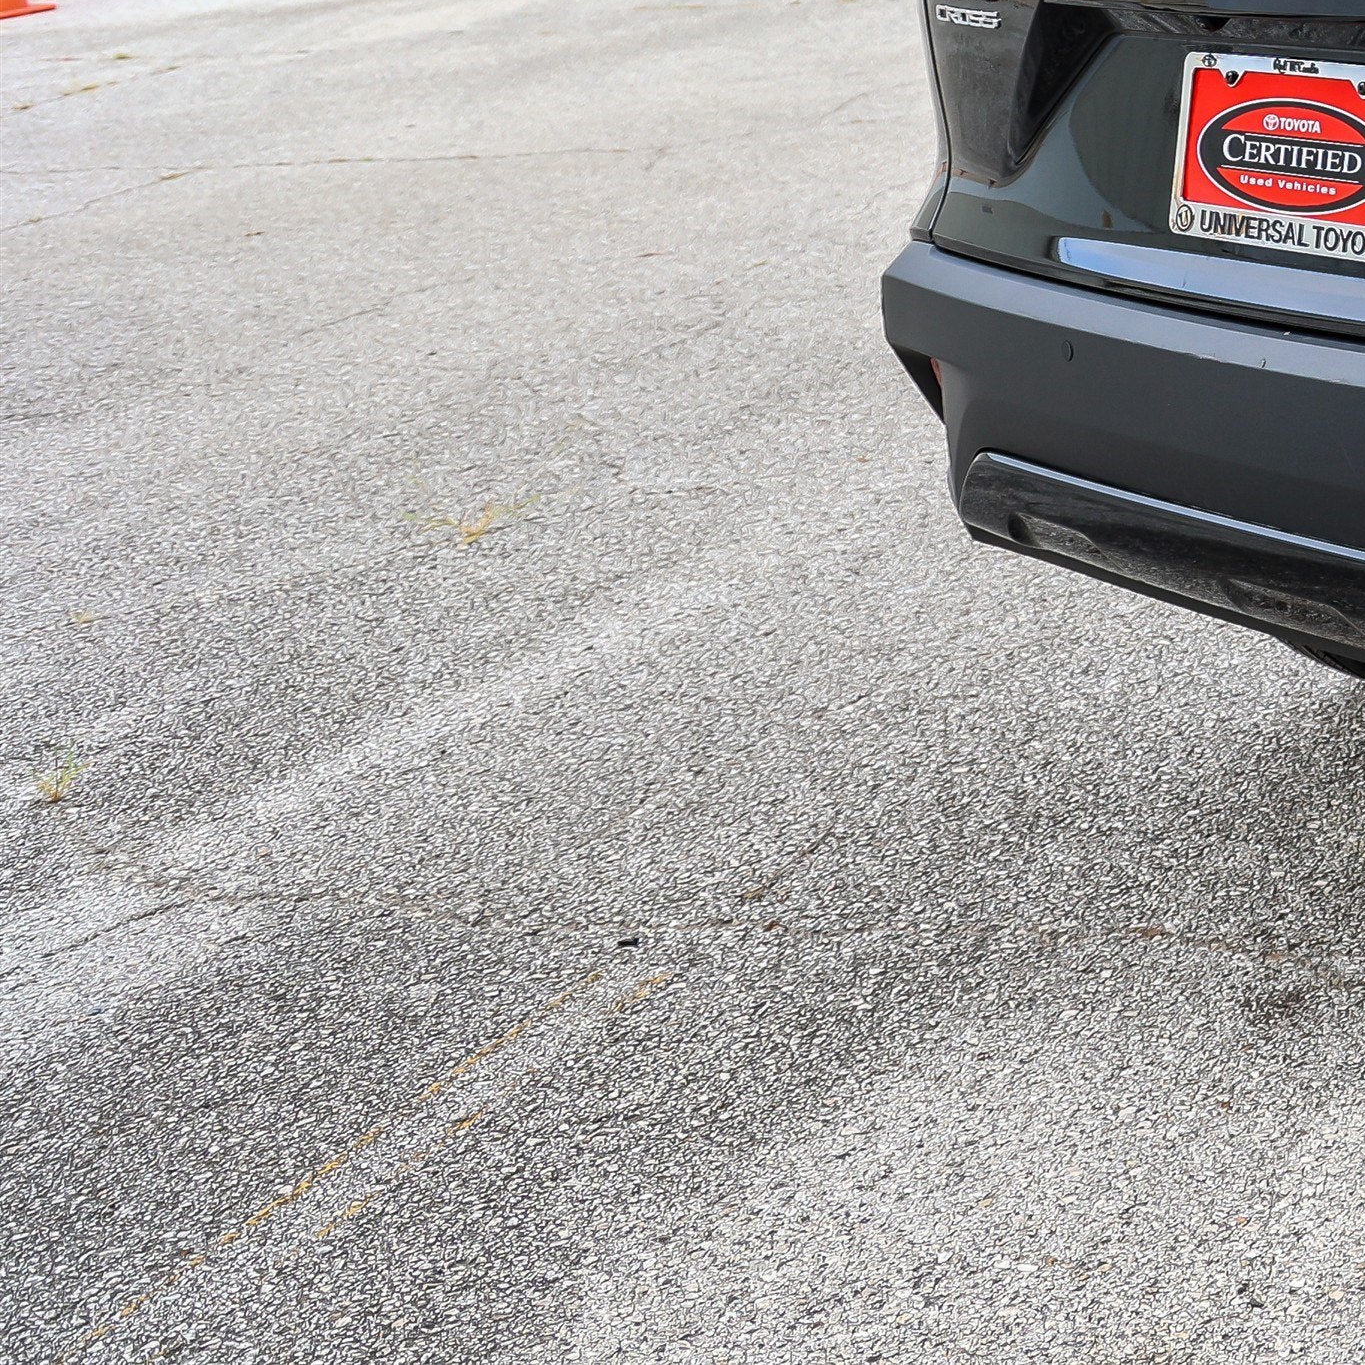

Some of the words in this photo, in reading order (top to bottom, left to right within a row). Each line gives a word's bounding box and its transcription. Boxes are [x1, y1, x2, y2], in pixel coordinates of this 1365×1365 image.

[935, 4, 1002, 29] CROSS
[1279, 116, 1321, 134] TOYOTA
[1222, 133, 1362, 174] CERTIFIED
[1239, 174, 1273, 188] Used
[1277, 179, 1337, 196] Vehicles
[1200, 209, 1309, 248] UNIVERSAL
